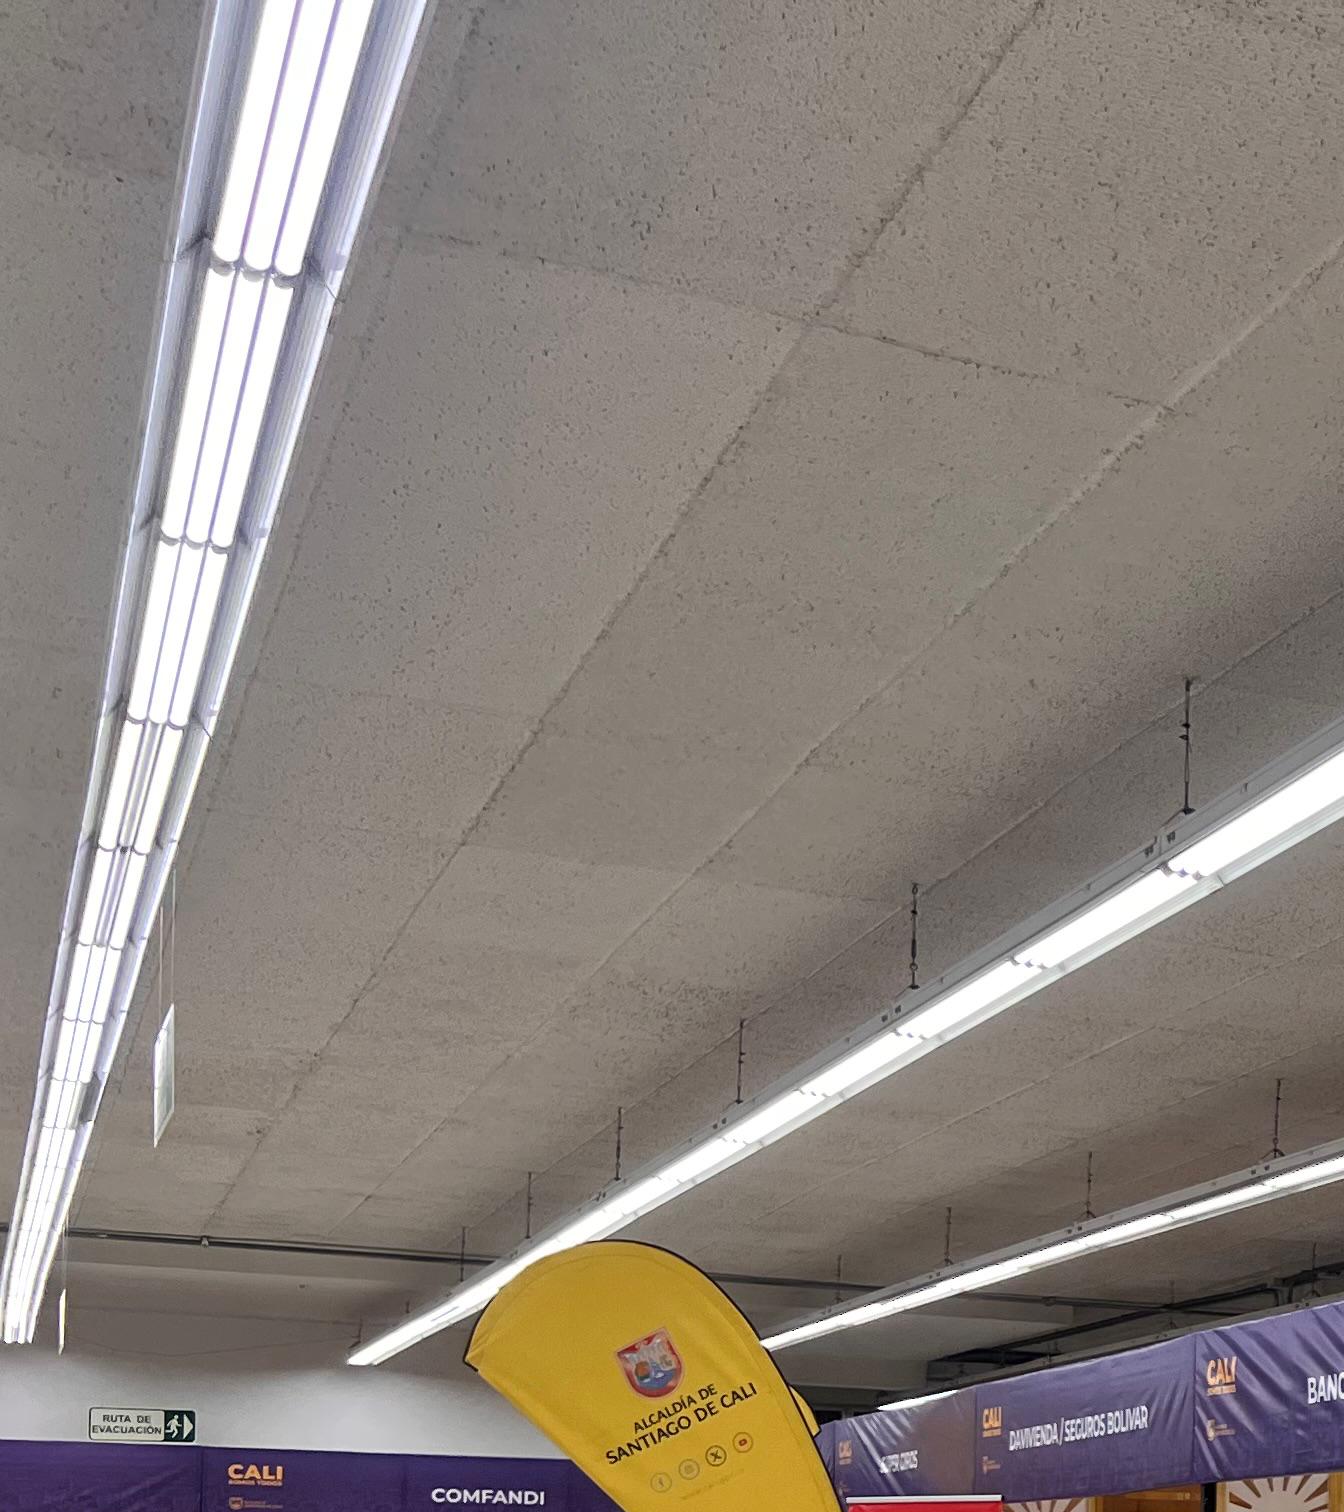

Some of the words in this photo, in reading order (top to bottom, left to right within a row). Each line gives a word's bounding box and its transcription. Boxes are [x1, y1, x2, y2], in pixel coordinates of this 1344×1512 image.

[1207, 1356, 1237, 1387] CALI
[102, 1413, 132, 1424] RUTA
[136, 1414, 151, 1424] DE
[605, 1415, 692, 1465] SANTIAGO
[693, 1401, 720, 1423] DE
[720, 1382, 758, 1409] CALI
[634, 1394, 698, 1435] ALCALDÍA
[697, 1383, 719, 1401] DE
[1064, 1413, 1106, 1442] SEGUROS
[228, 1463, 284, 1482] CALI
[431, 1487, 545, 1506] COMFANDI
